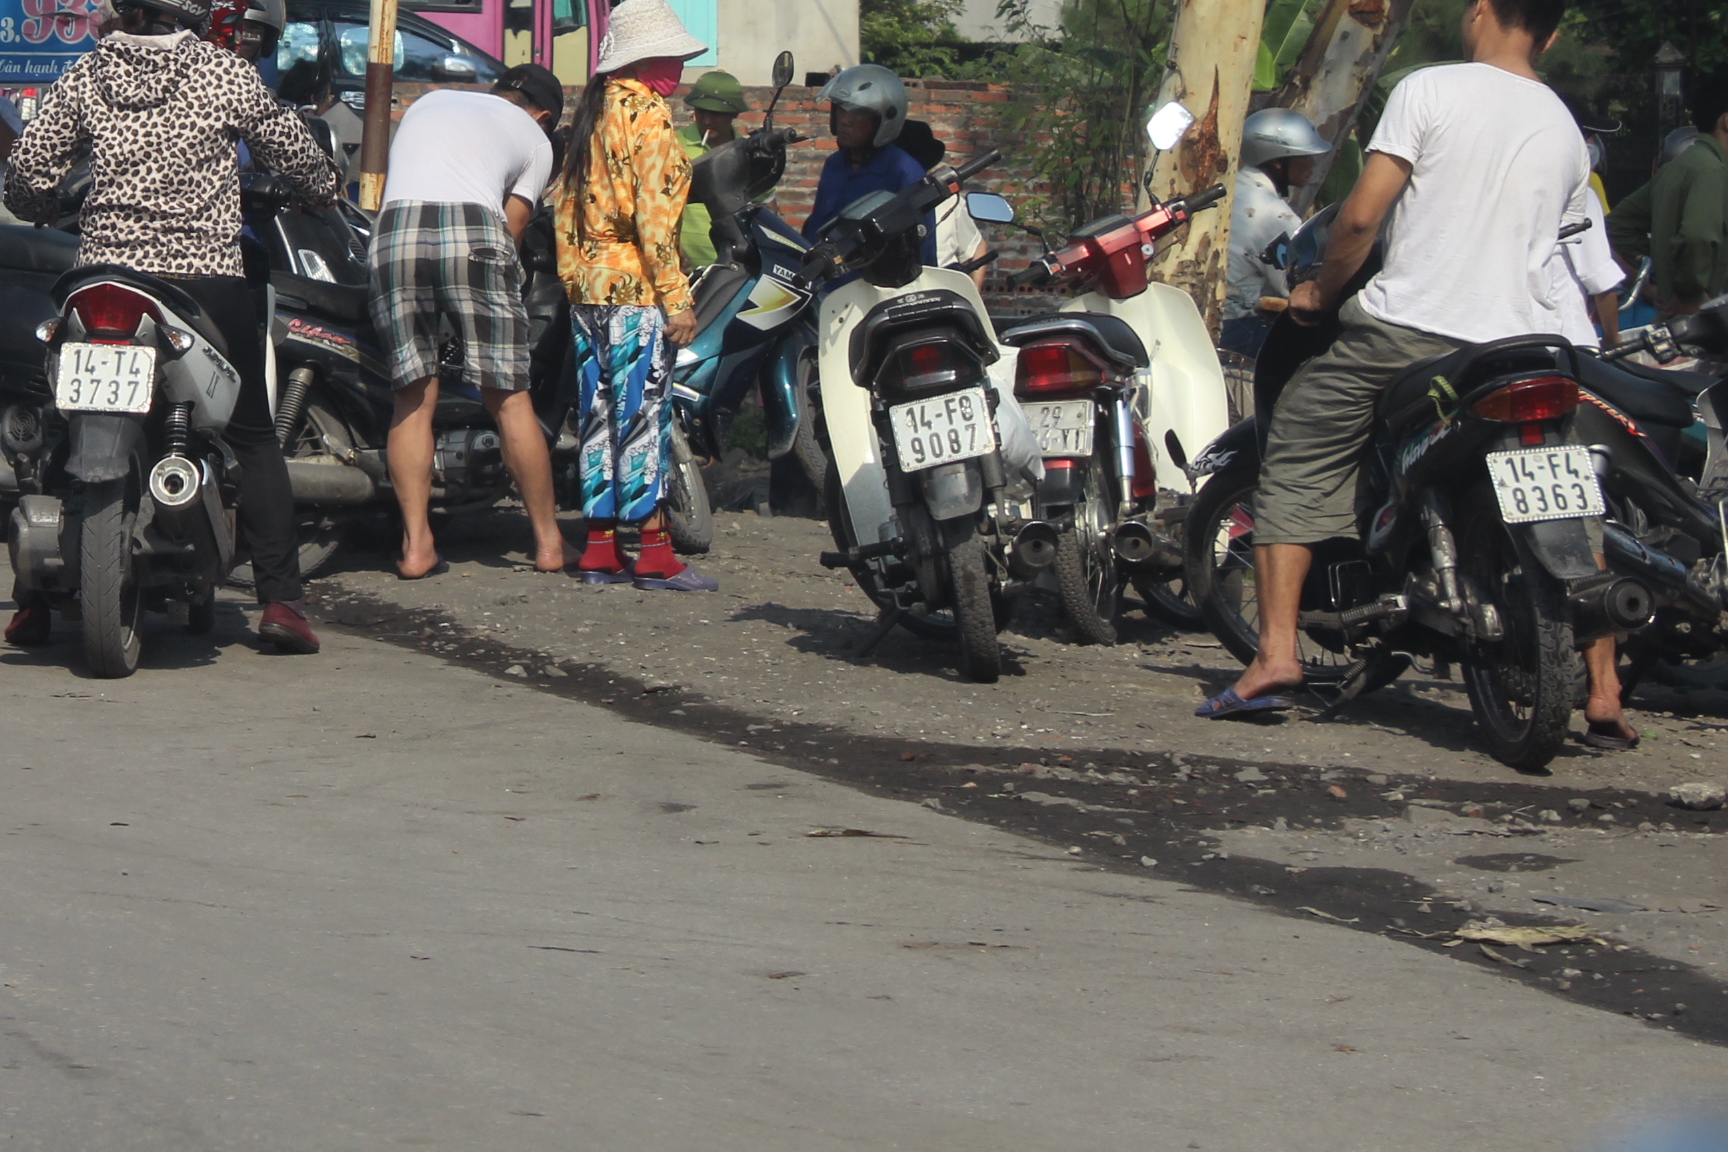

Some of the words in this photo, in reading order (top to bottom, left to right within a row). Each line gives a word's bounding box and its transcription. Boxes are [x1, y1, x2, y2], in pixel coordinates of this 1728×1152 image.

[73, 349, 140, 378] 14-T4
[69, 379, 140, 407] 3737
[910, 422, 978, 465] 9087
[1505, 452, 1580, 483] 14-F4
[1512, 483, 1589, 516] 8363
